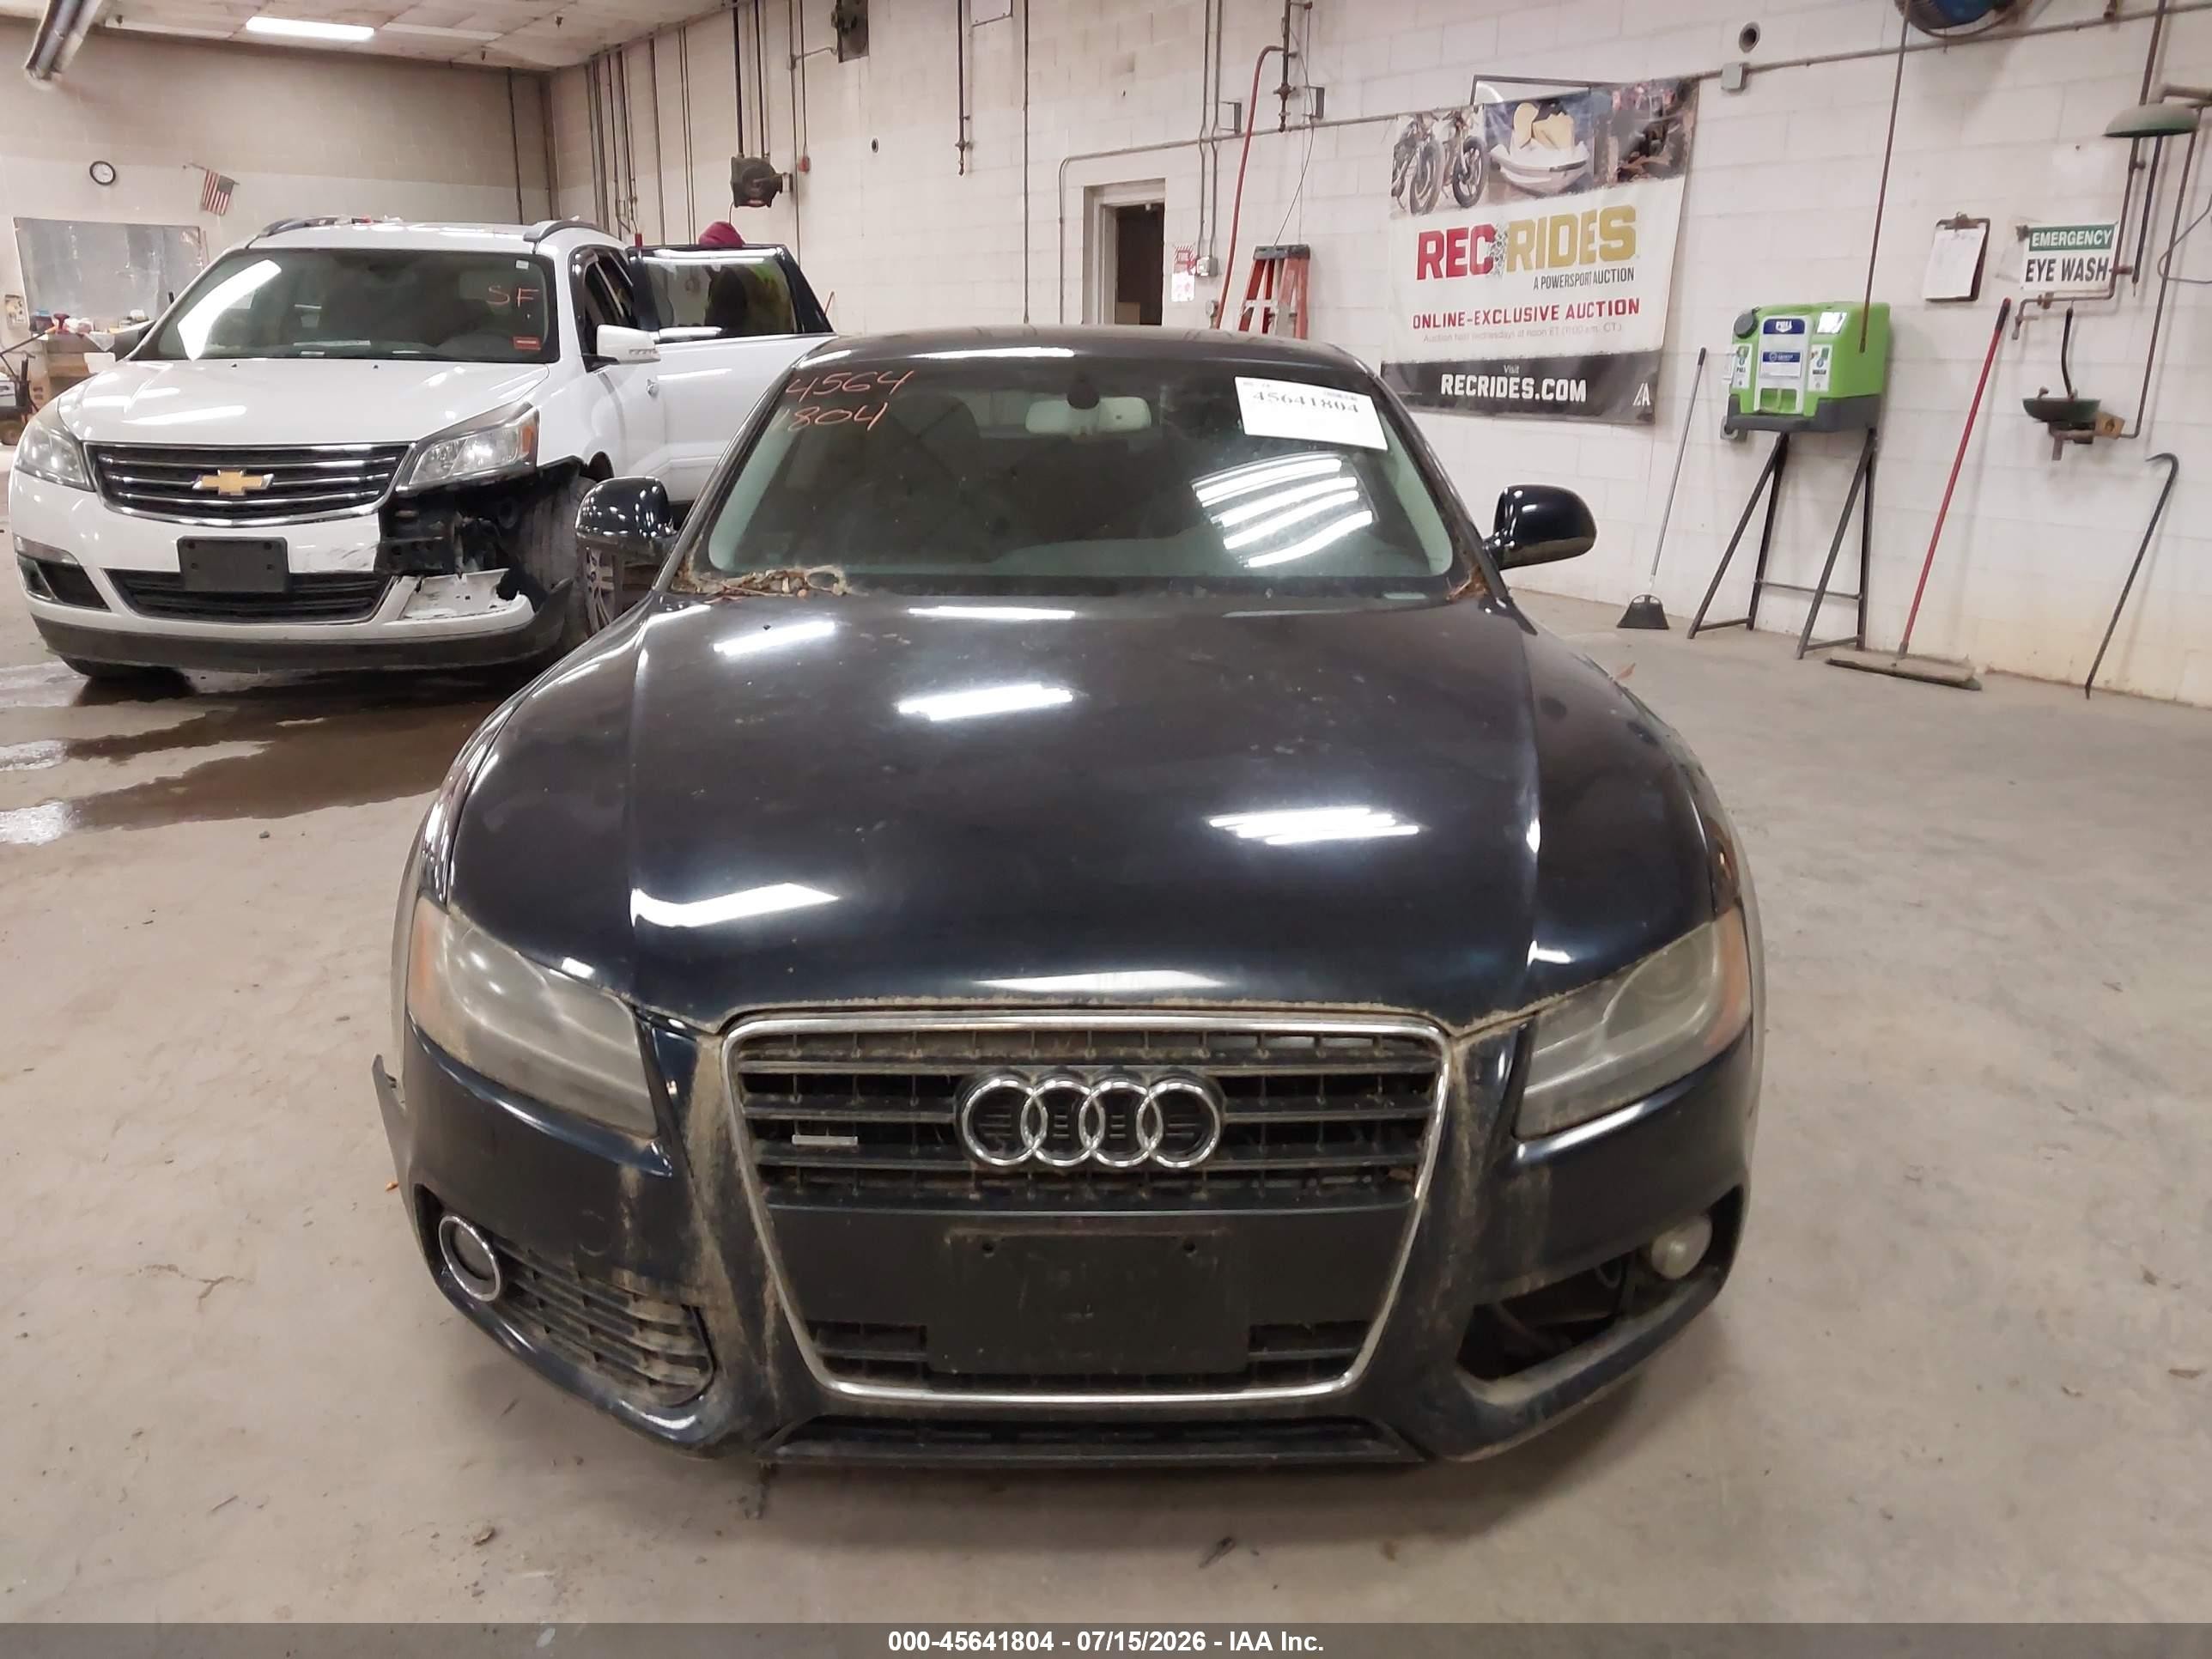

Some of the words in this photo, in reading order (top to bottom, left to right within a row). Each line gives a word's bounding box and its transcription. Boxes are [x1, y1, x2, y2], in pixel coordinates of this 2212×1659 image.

[1417, 223, 1496, 280] REC
[1505, 204, 1637, 272] RIDES
[2032, 229, 2112, 247] EMERGENCY
[1534, 278, 1540, 290] A
[1593, 267, 1635, 284] AUCTION
[2025, 258, 2057, 283] EYE
[2060, 257, 2110, 282] WASH
[1413, 304, 1560, 330] ONLINE-EXCLUSIVE
[1565, 297, 1641, 319] AUCTION
[1504, 364, 1520, 374] Visit
[785, 370, 915, 403] 4564
[1440, 374, 1588, 403] RECRIDES.COM
[1253, 391, 1359, 413] 45641804
